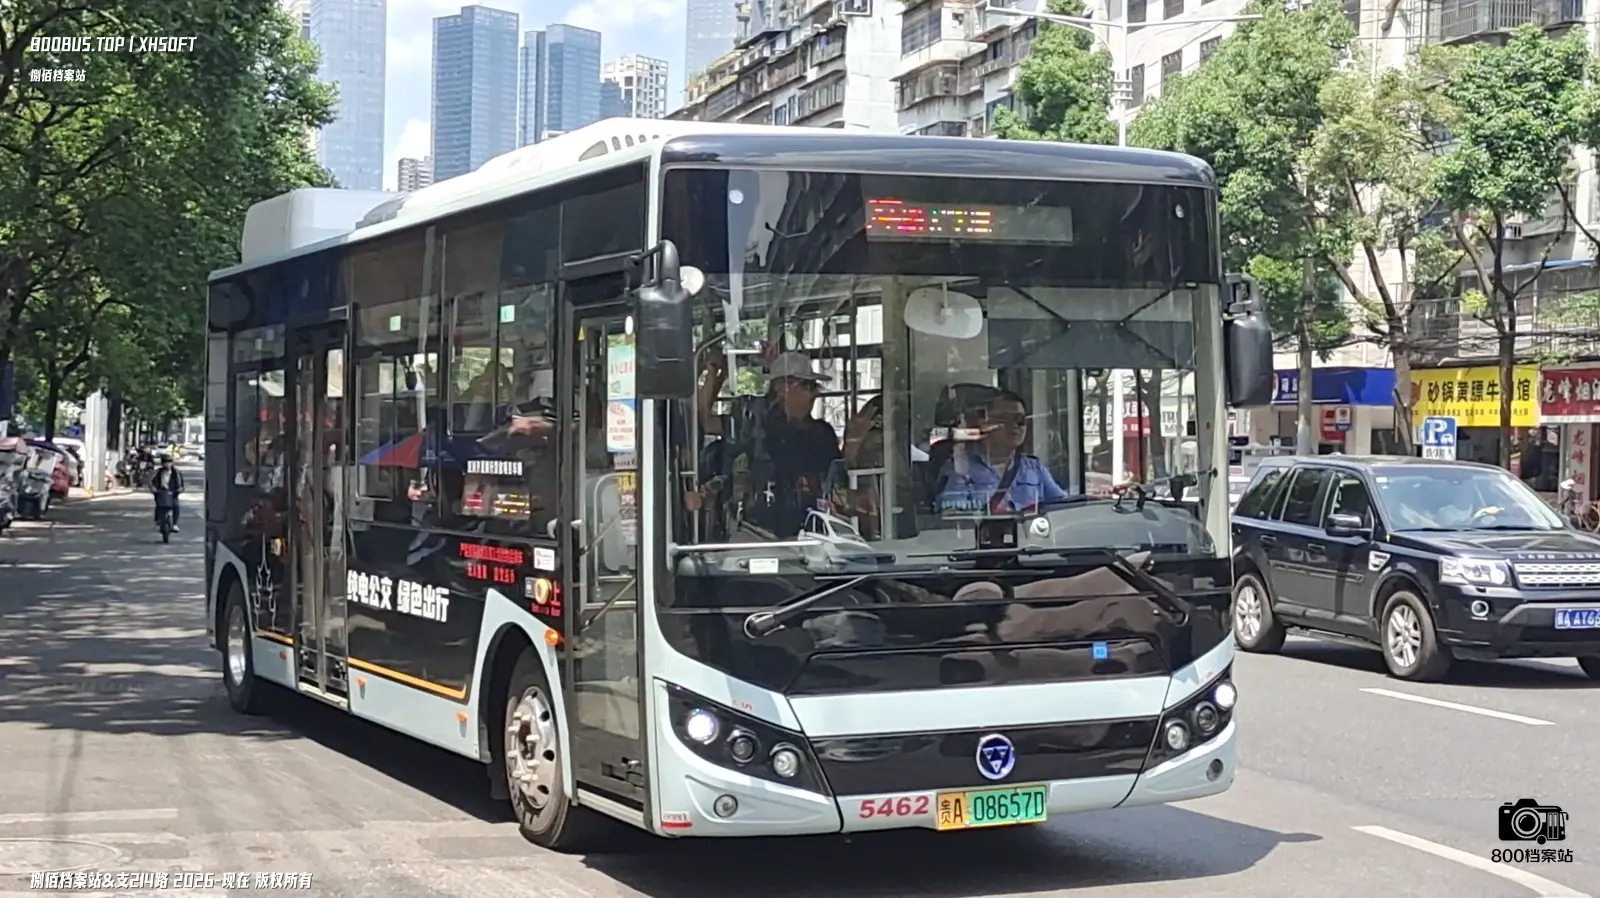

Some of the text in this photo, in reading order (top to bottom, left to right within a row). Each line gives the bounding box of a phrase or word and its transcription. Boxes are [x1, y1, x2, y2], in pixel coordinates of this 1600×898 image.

[1427, 377, 1531, 403] 砂锅黄膘牛馆
[346, 569, 450, 623] 纯电公交 绿色出行
[859, 795, 930, 819] 5462
[973, 791, 1045, 822] 08657D
